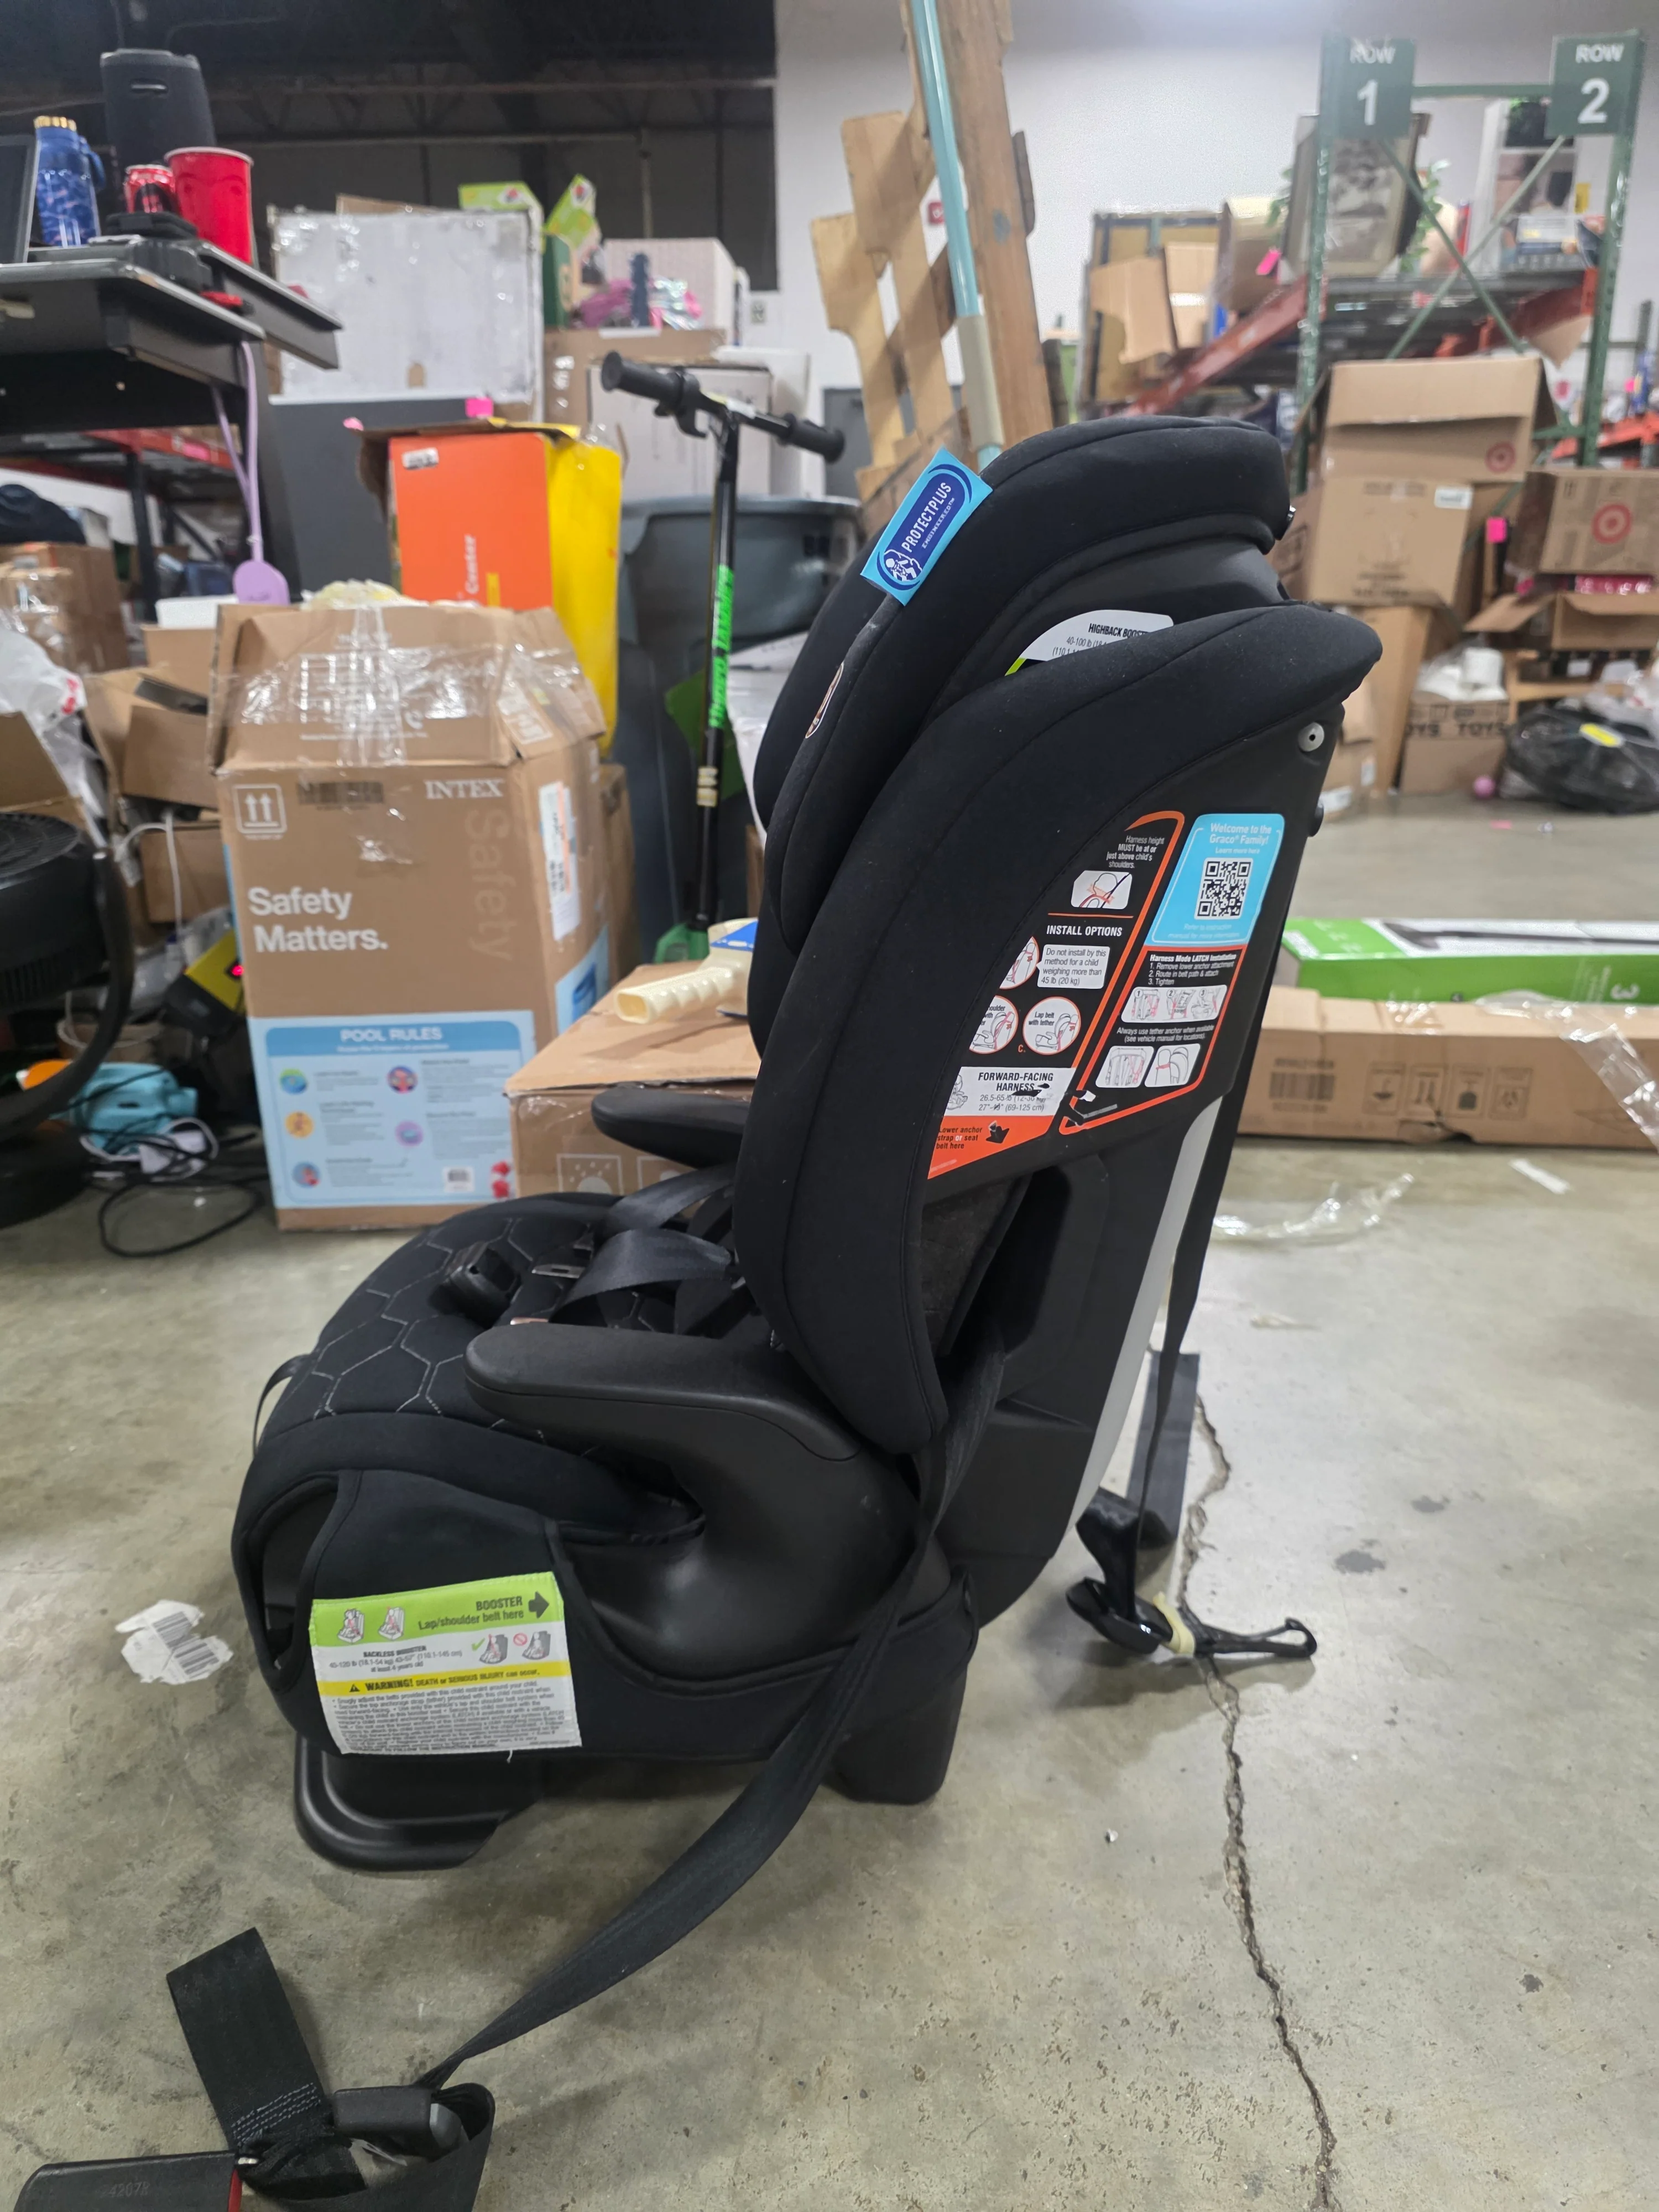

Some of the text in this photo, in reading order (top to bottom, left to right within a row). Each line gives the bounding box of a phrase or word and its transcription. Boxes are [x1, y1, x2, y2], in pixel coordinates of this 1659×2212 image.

[1350, 44, 1396, 65] ROW
[1575, 43, 1624, 63] ROW
[1357, 79, 1378, 126] 1
[1577, 77, 1609, 124] 2
[901, 482, 951, 552] PROTECTPLUS
[1088, 623, 1123, 637] HIGHBACK
[1066, 637, 1086, 646] 40-100
[425, 779, 505, 800] INTEX
[1211, 822, 1272, 834] Welcome to the
[1125, 836, 1165, 846] Harness height
[1240, 835, 1269, 846] Family!
[1118, 843, 1135, 852] MUST
[1106, 852, 1117, 860] just
[1135, 853, 1152, 861] child's
[247, 885, 352, 921] Safety
[1046, 925, 1123, 937] INSTALL OPTIONS
[253, 924, 389, 953] Matters.
[1087, 949, 1094, 958] by
[1043, 968, 1070, 976] weighing
[1058, 977, 1069, 985] (20
[1070, 977, 1080, 986] kg)
[1155, 978, 1175, 987] Tighten
[340, 1027, 443, 1042] POOL RULES
[1117, 1027, 1138, 1035] Always
[1018, 1044, 1026, 1053] C.
[978, 1072, 1053, 1081] FORWARD-FACING
[996, 1082, 1035, 1091] HARNESS
[1005, 1104, 1030, 1112] (69-125
[1032, 1104, 1044, 1113] cm)
[476, 1596, 523, 1611] BOOSTER
[418, 1610, 524, 1630] Lap/shoulder belt here
[365, 1678, 414, 1691] WARNING!
[416, 1678, 439, 1687] DEATH
